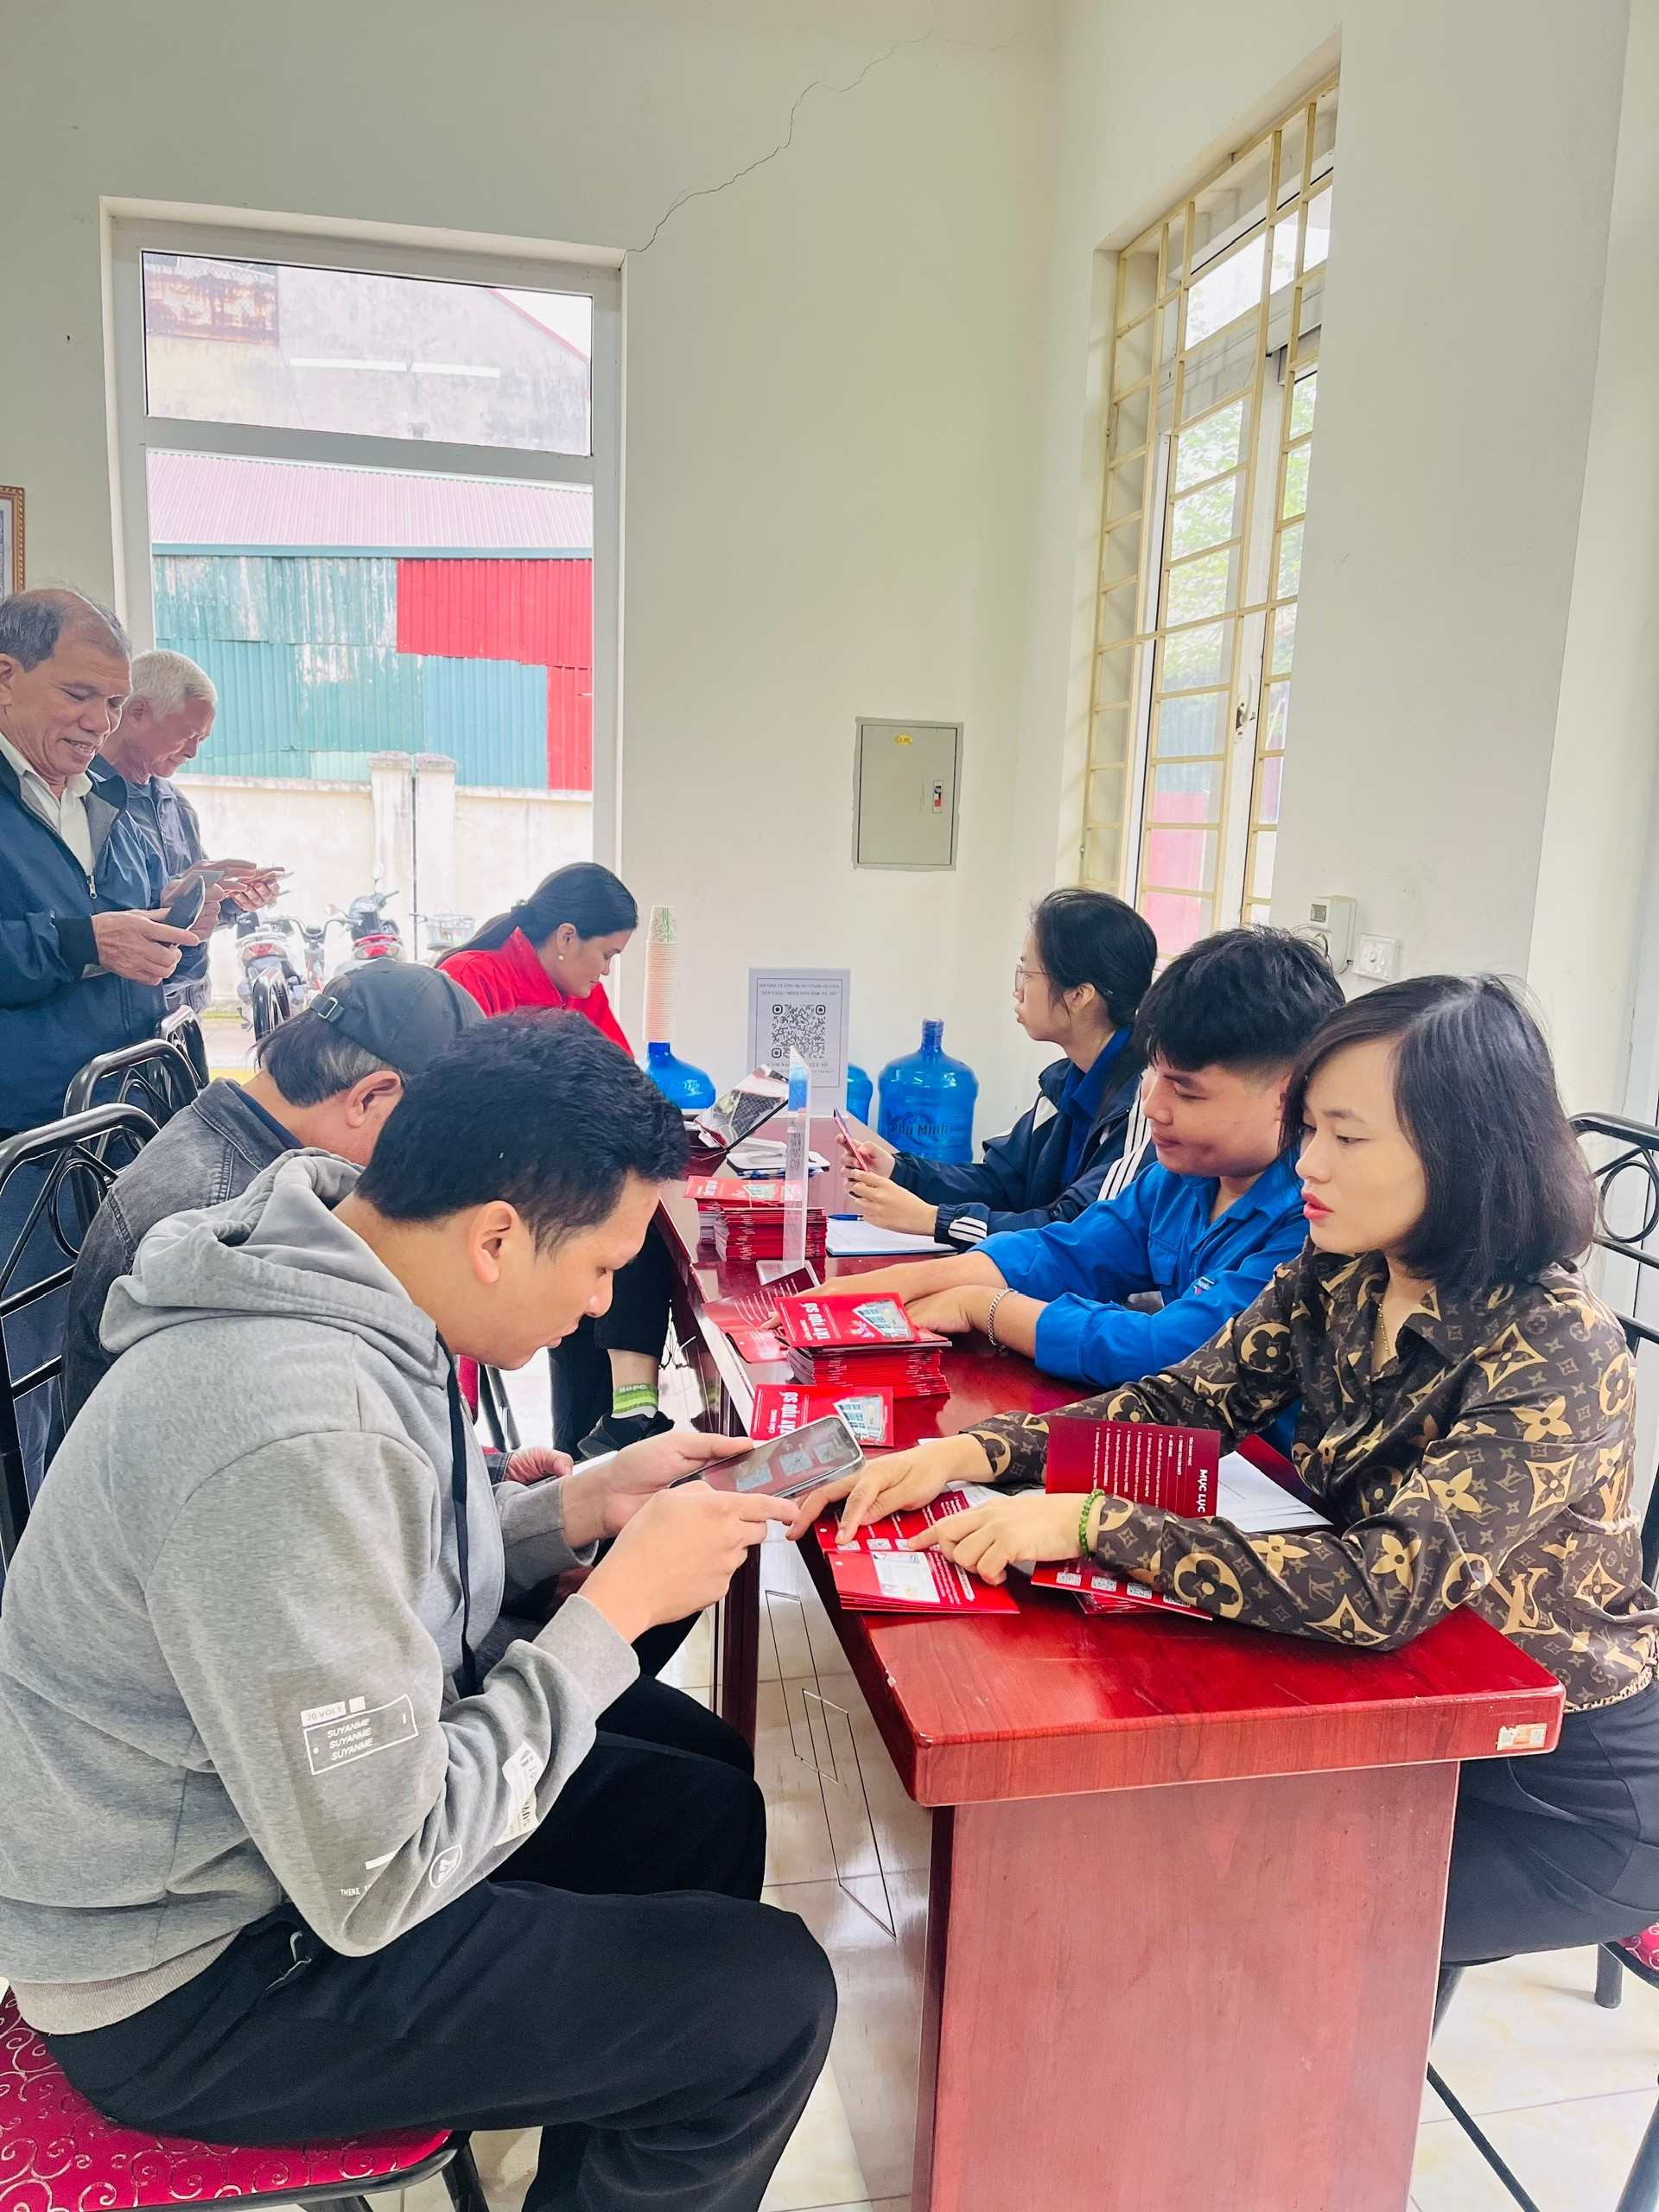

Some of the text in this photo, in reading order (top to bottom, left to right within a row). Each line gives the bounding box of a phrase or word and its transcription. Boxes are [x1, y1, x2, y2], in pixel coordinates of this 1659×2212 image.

[918, 1122, 949, 1135] Minh
[779, 1391, 798, 1403] SỐ
[781, 1403, 800, 1418] TỰU
[1196, 1469, 1208, 1513] MỤC LỤC
[307, 1707, 342, 1721] 20 VOLT
[327, 1718, 371, 1738] SUYANME
[328, 1727, 372, 1750] SUYANME
[331, 1738, 373, 1761] SUYANME
[340, 1887, 361, 1897] THERE
